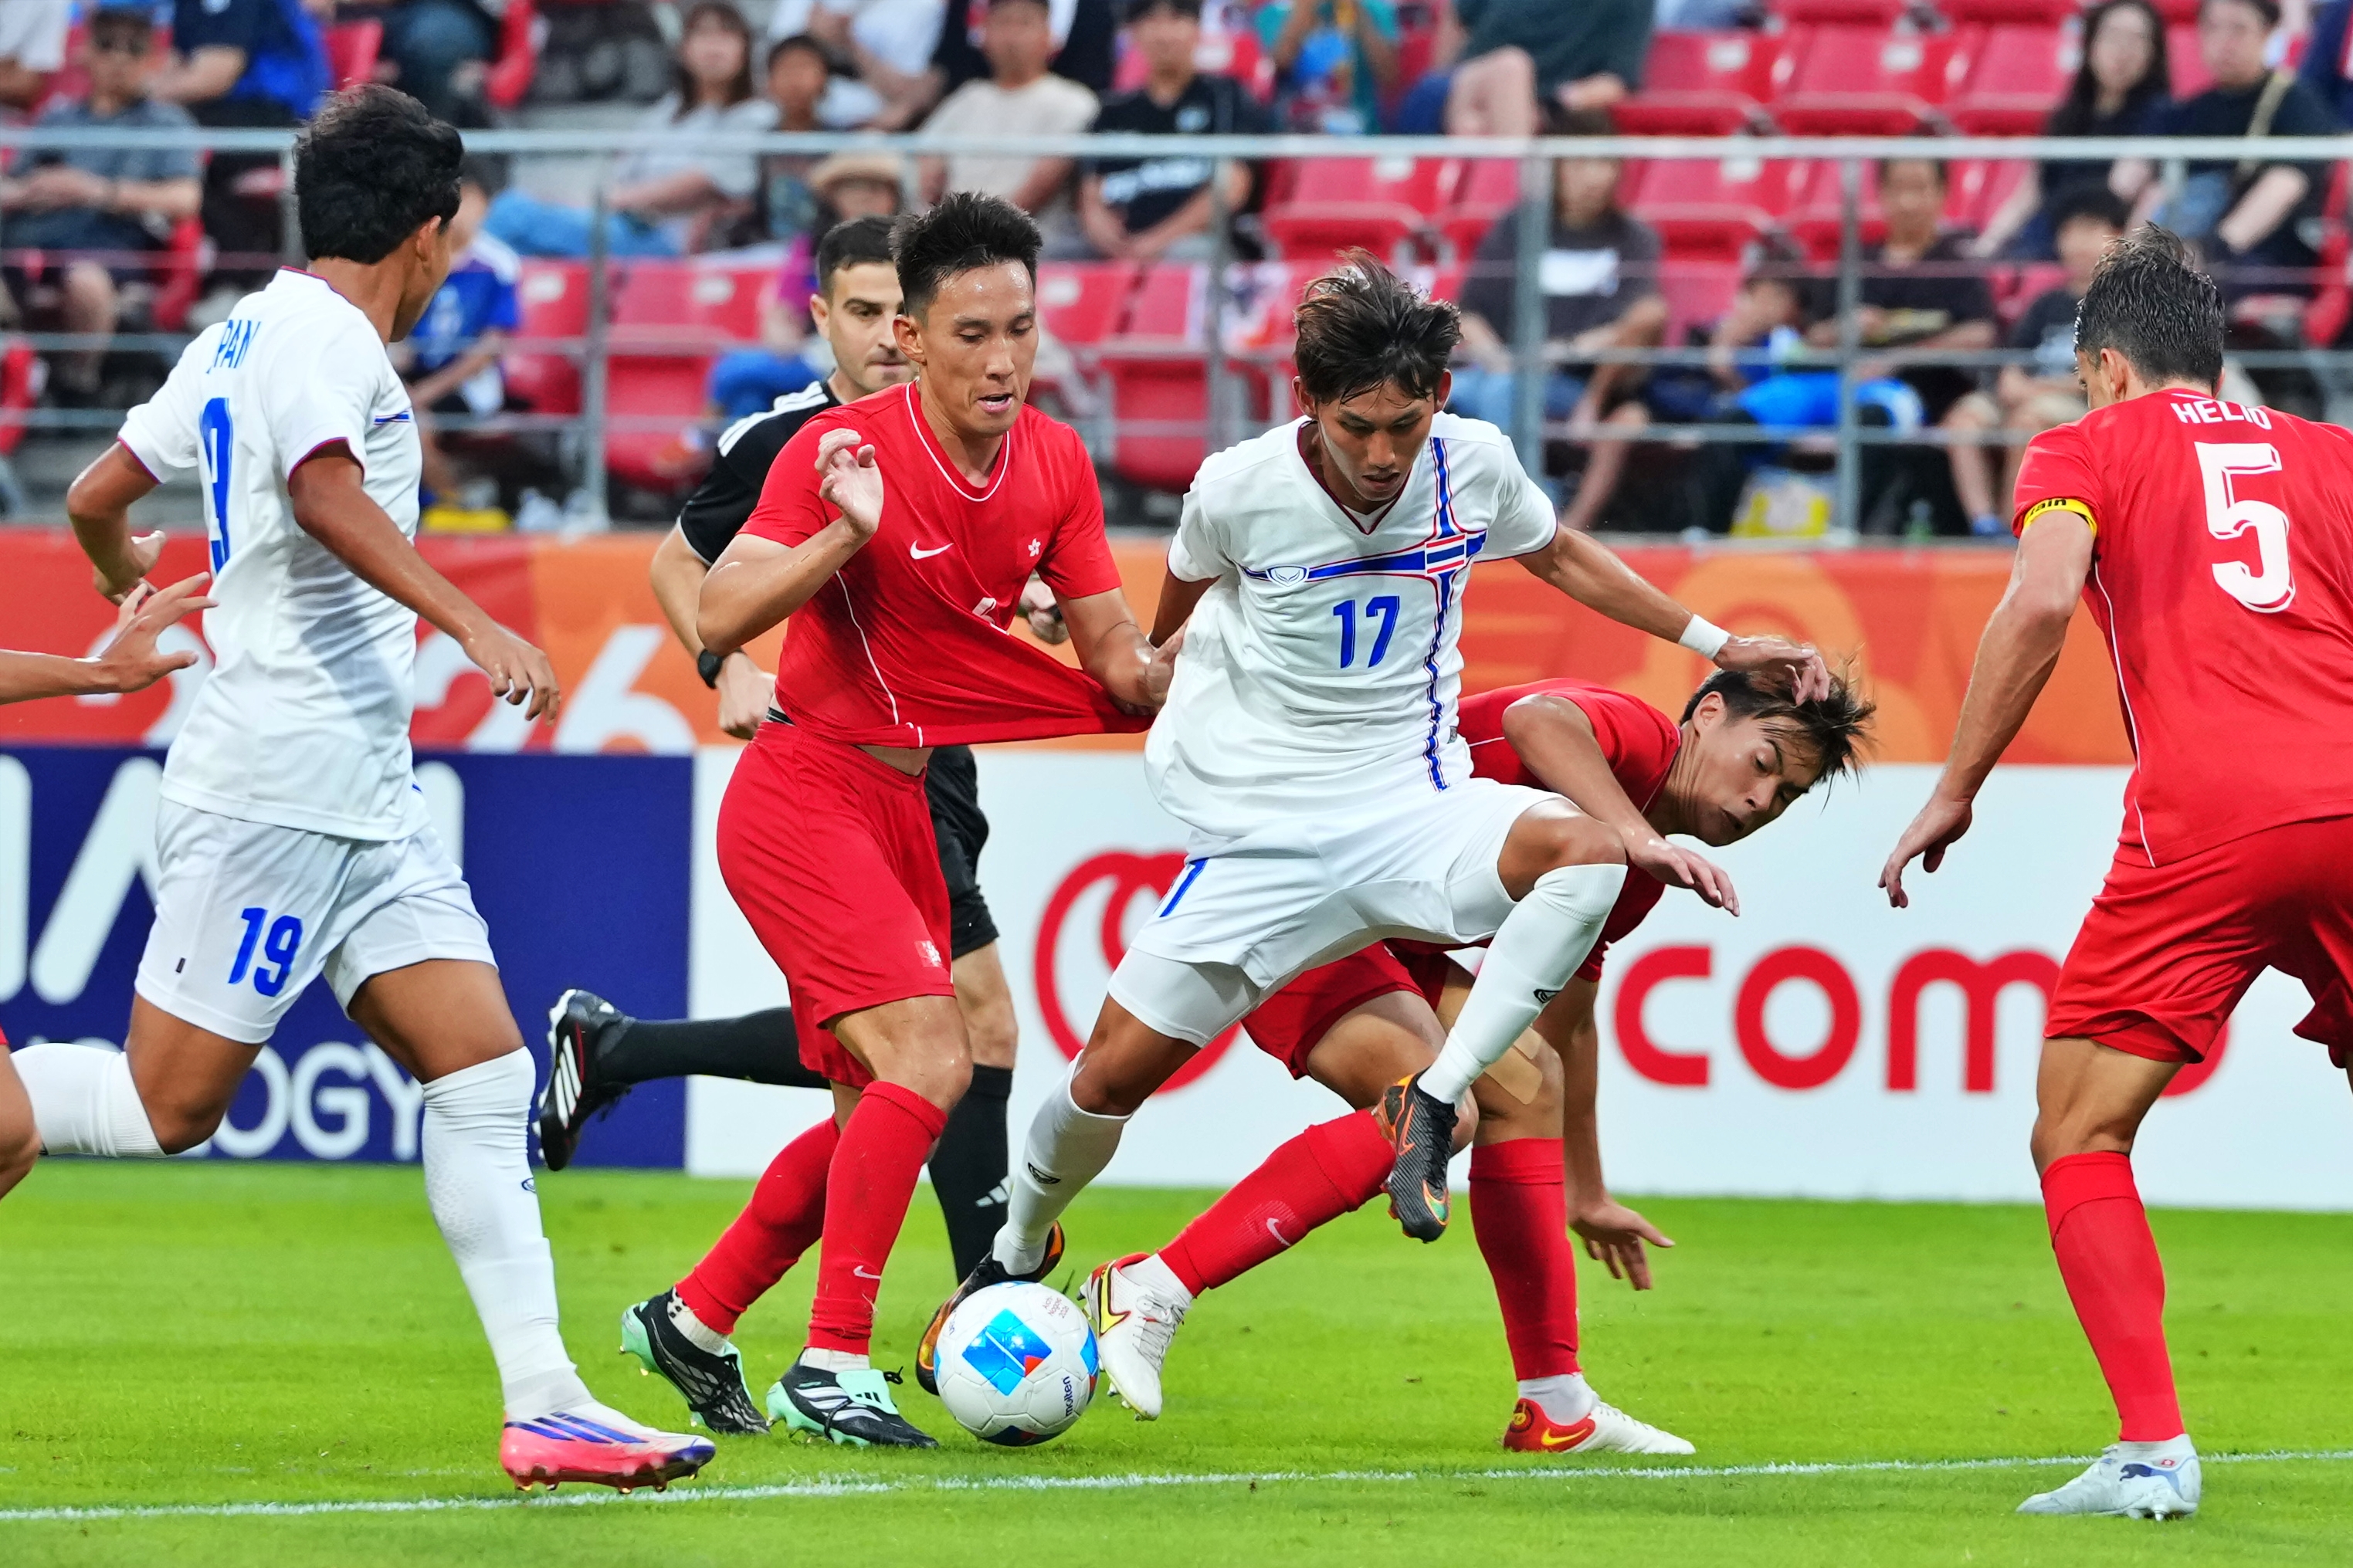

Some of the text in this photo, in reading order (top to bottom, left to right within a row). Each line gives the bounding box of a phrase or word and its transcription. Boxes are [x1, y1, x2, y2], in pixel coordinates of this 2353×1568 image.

[205, 319, 262, 374] PAN
[2171, 400, 2273, 430] HELIO
[2194, 441, 2297, 614] 5
[1333, 595, 1400, 669] 17
[227, 907, 303, 997] 19
[1612, 943, 2230, 1099] com
[179, 1042, 422, 1159] OGY
[1063, 1375, 1074, 1417] molten
